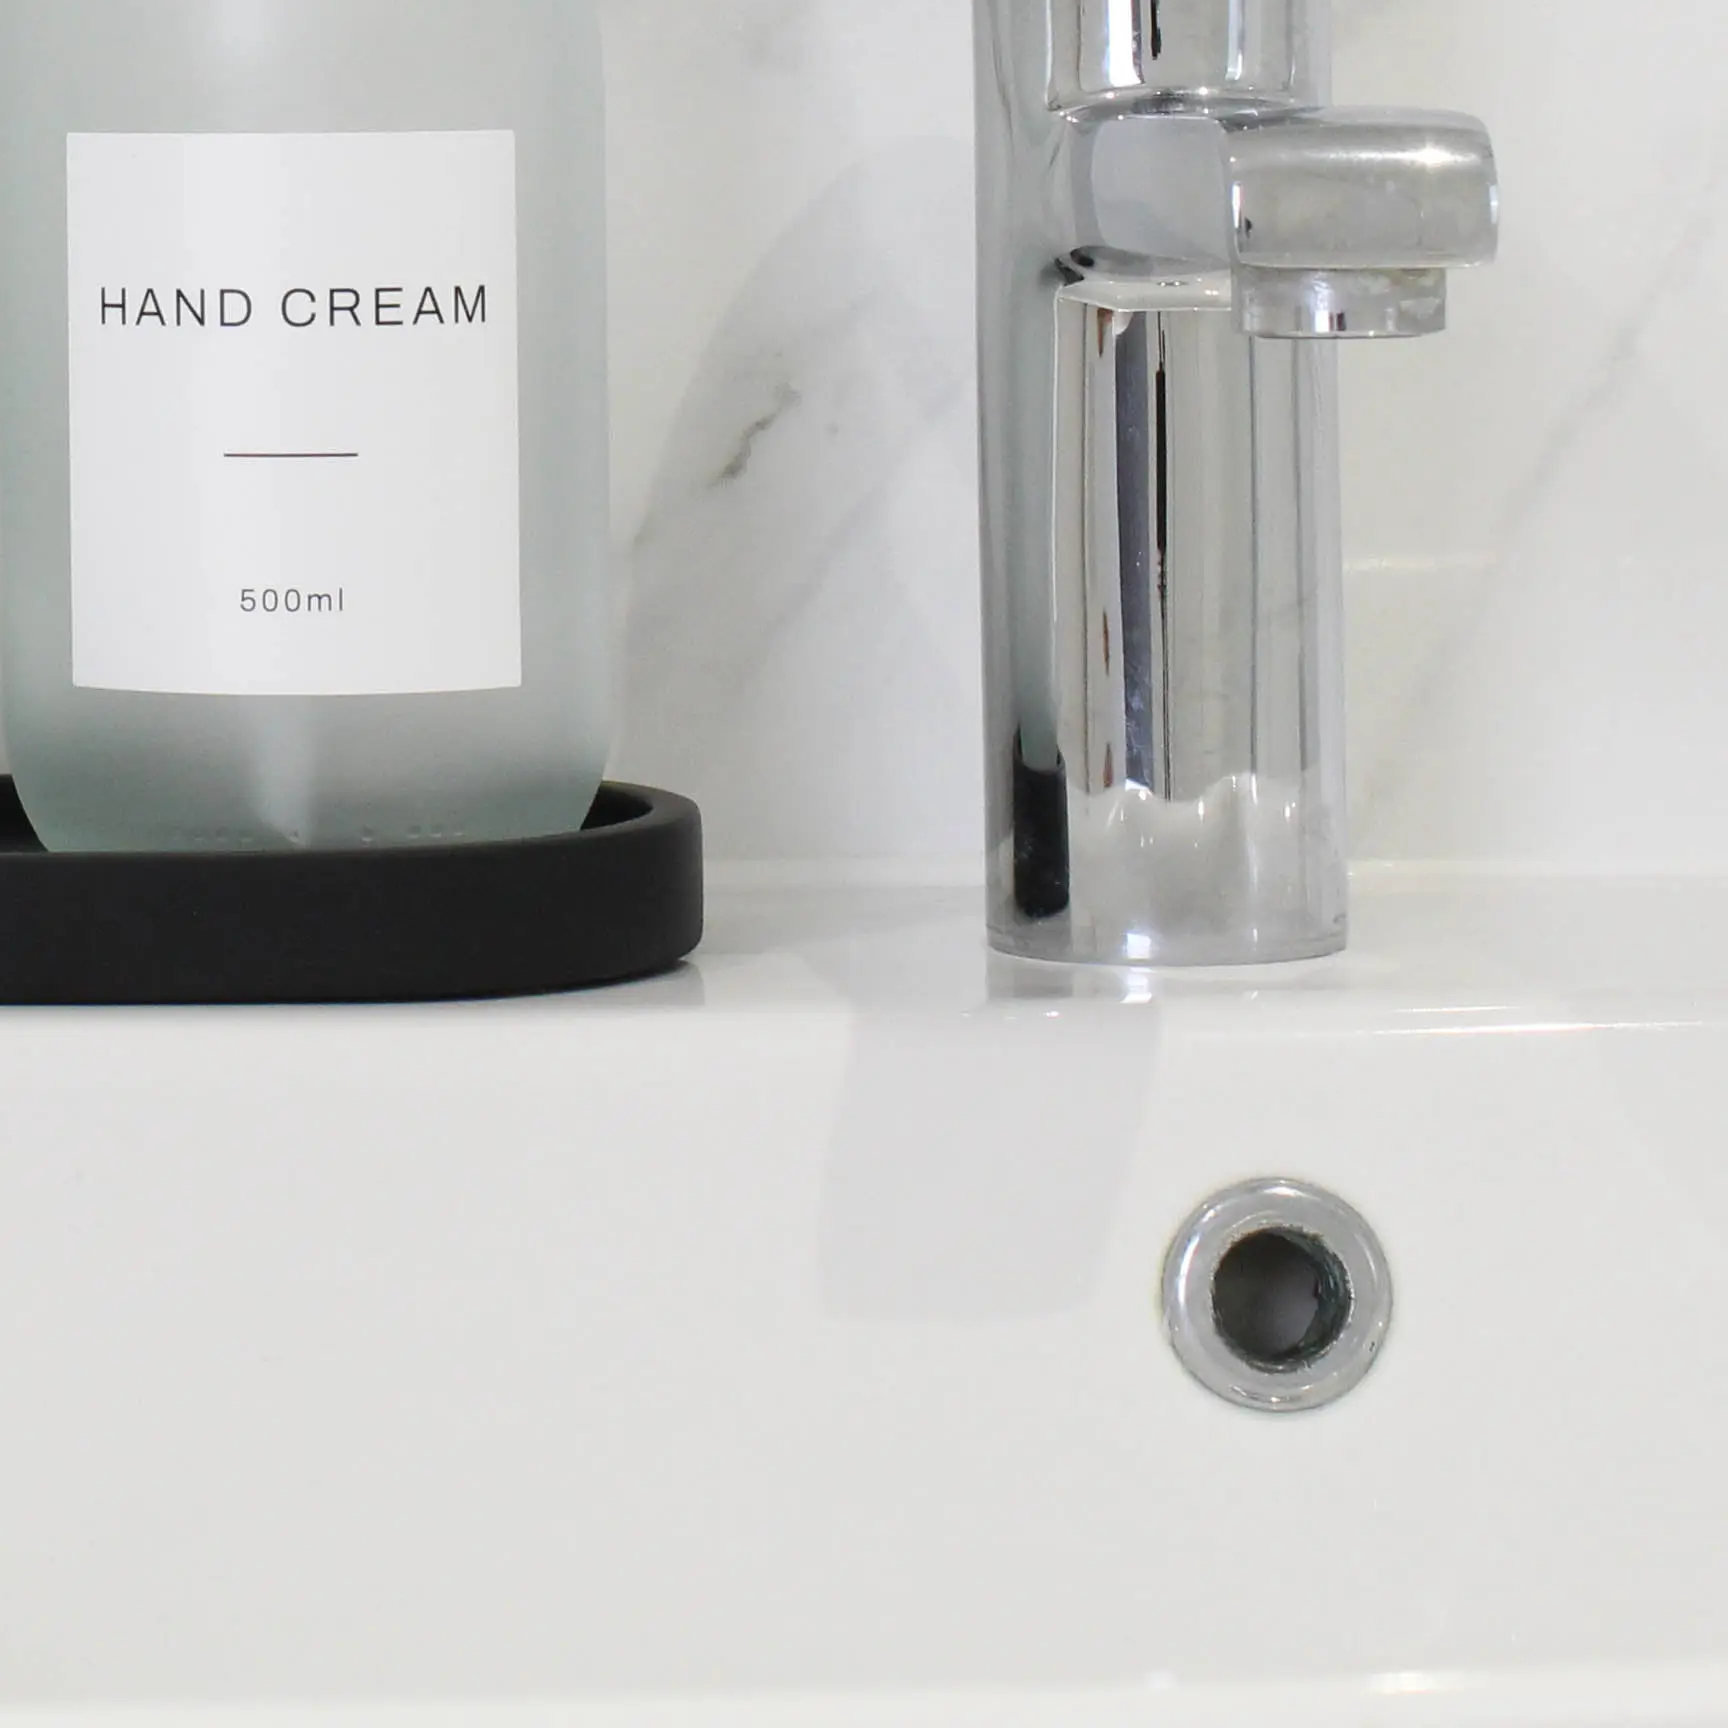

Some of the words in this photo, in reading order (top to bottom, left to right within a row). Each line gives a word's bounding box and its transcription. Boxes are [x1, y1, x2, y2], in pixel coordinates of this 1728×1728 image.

[100, 285, 253, 328] HAND
[280, 283, 488, 329] CREAM
[238, 586, 345, 614] 500ml
